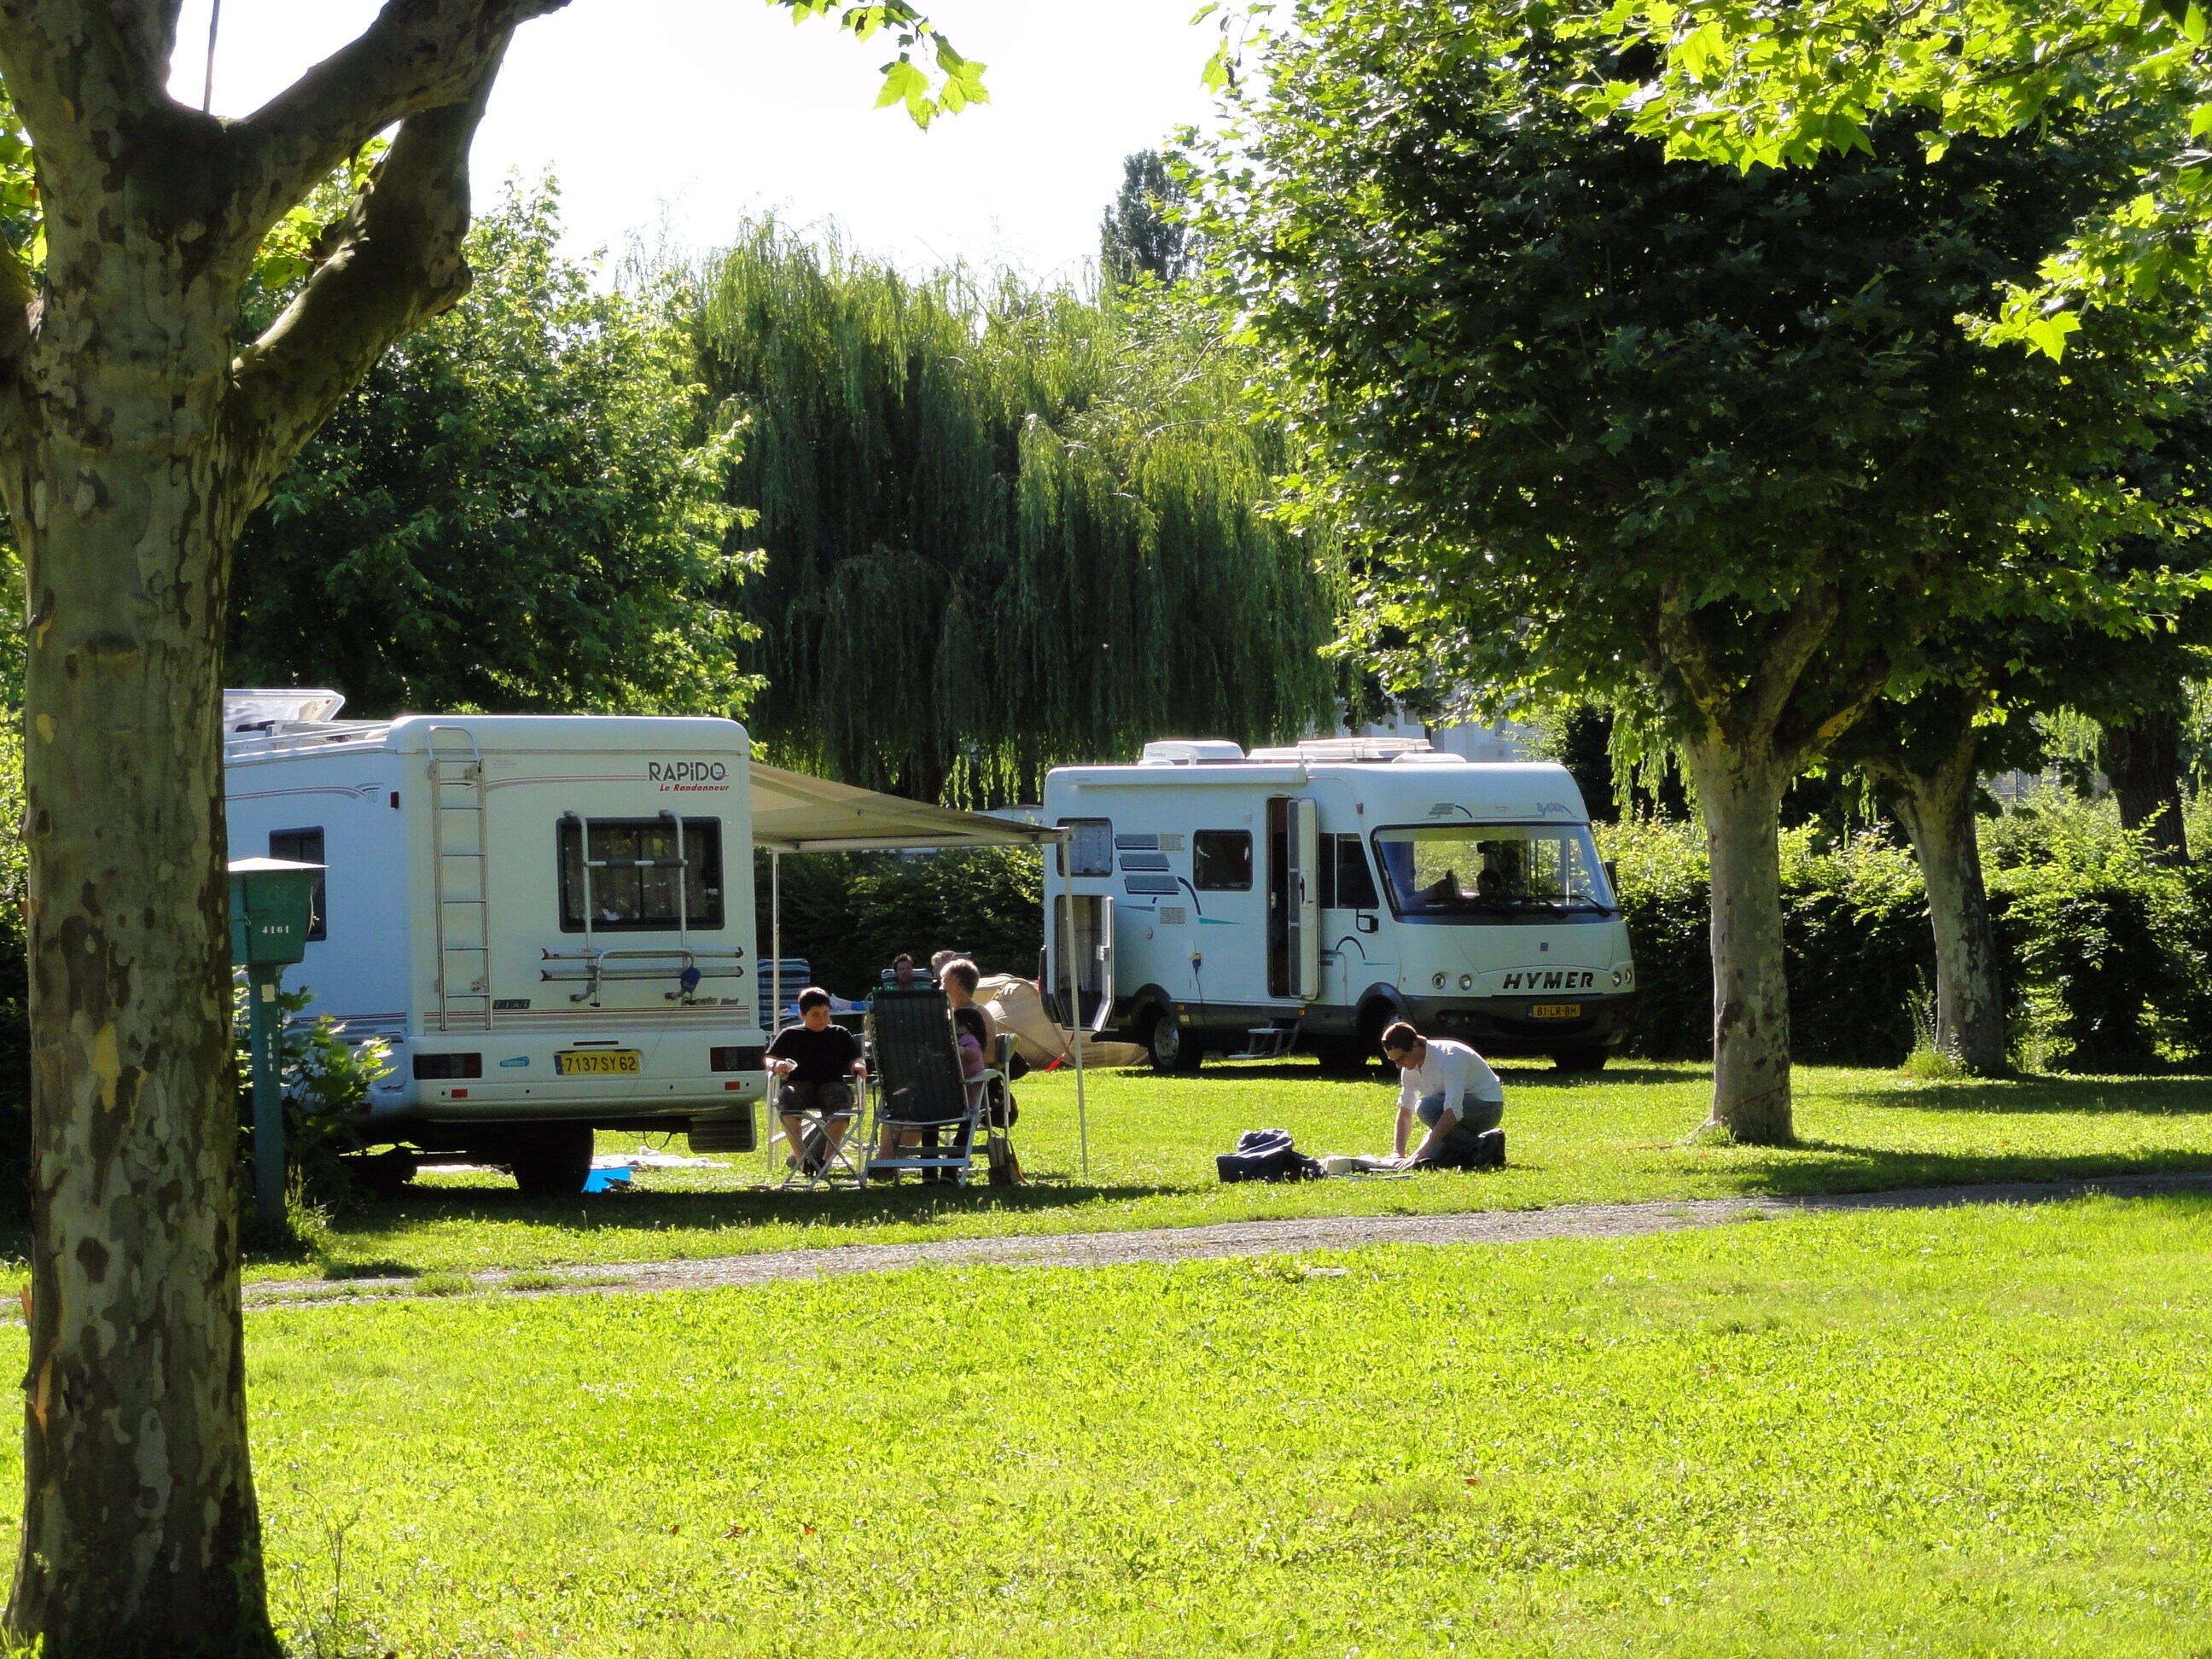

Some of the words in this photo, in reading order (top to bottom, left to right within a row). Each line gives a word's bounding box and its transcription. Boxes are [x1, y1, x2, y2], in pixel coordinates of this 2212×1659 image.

[673, 783, 730, 792] Randonneur
[262, 925, 289, 934] 4161
[1502, 971, 1594, 990] HYMER
[1536, 1006, 1577, 1016] 81-LR-BH
